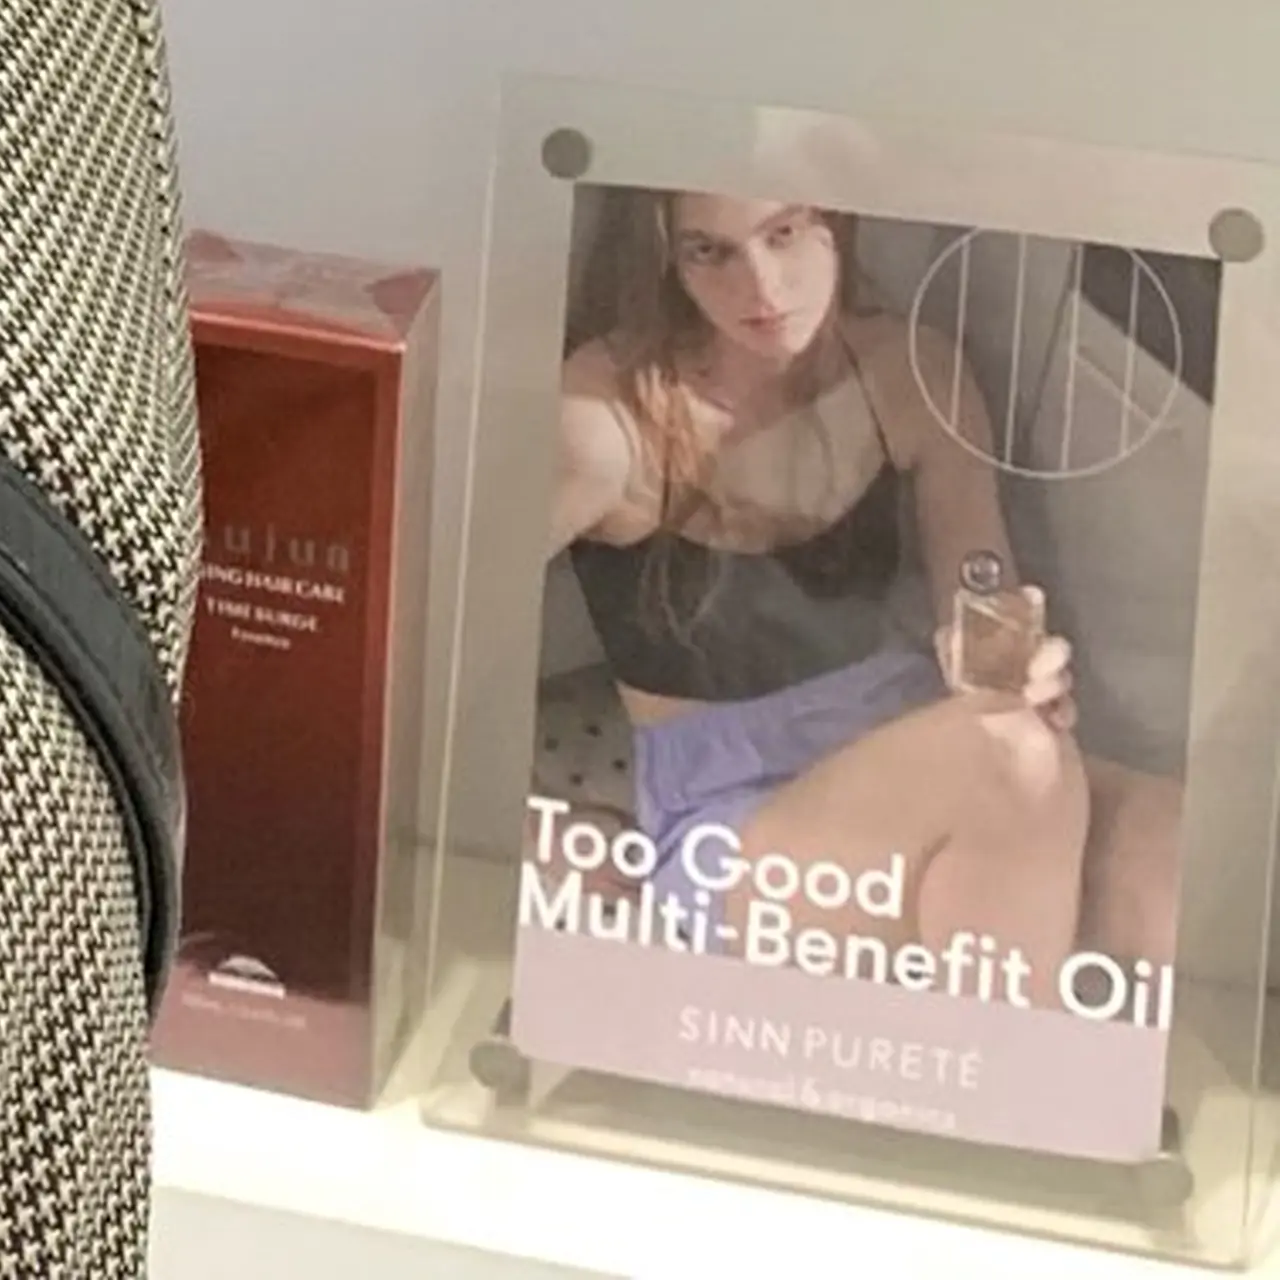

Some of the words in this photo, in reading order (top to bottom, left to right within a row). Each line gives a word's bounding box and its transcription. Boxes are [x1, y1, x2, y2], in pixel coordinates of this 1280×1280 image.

[207, 523, 350, 573] ujua
[527, 797, 656, 878] Too
[682, 824, 904, 920] Good
[520, 860, 1032, 1009] Multi-Benefit
[1059, 951, 1174, 1032] Oil
[679, 1005, 791, 1058] SINN
[802, 1024, 983, 1090] PURETÉ
